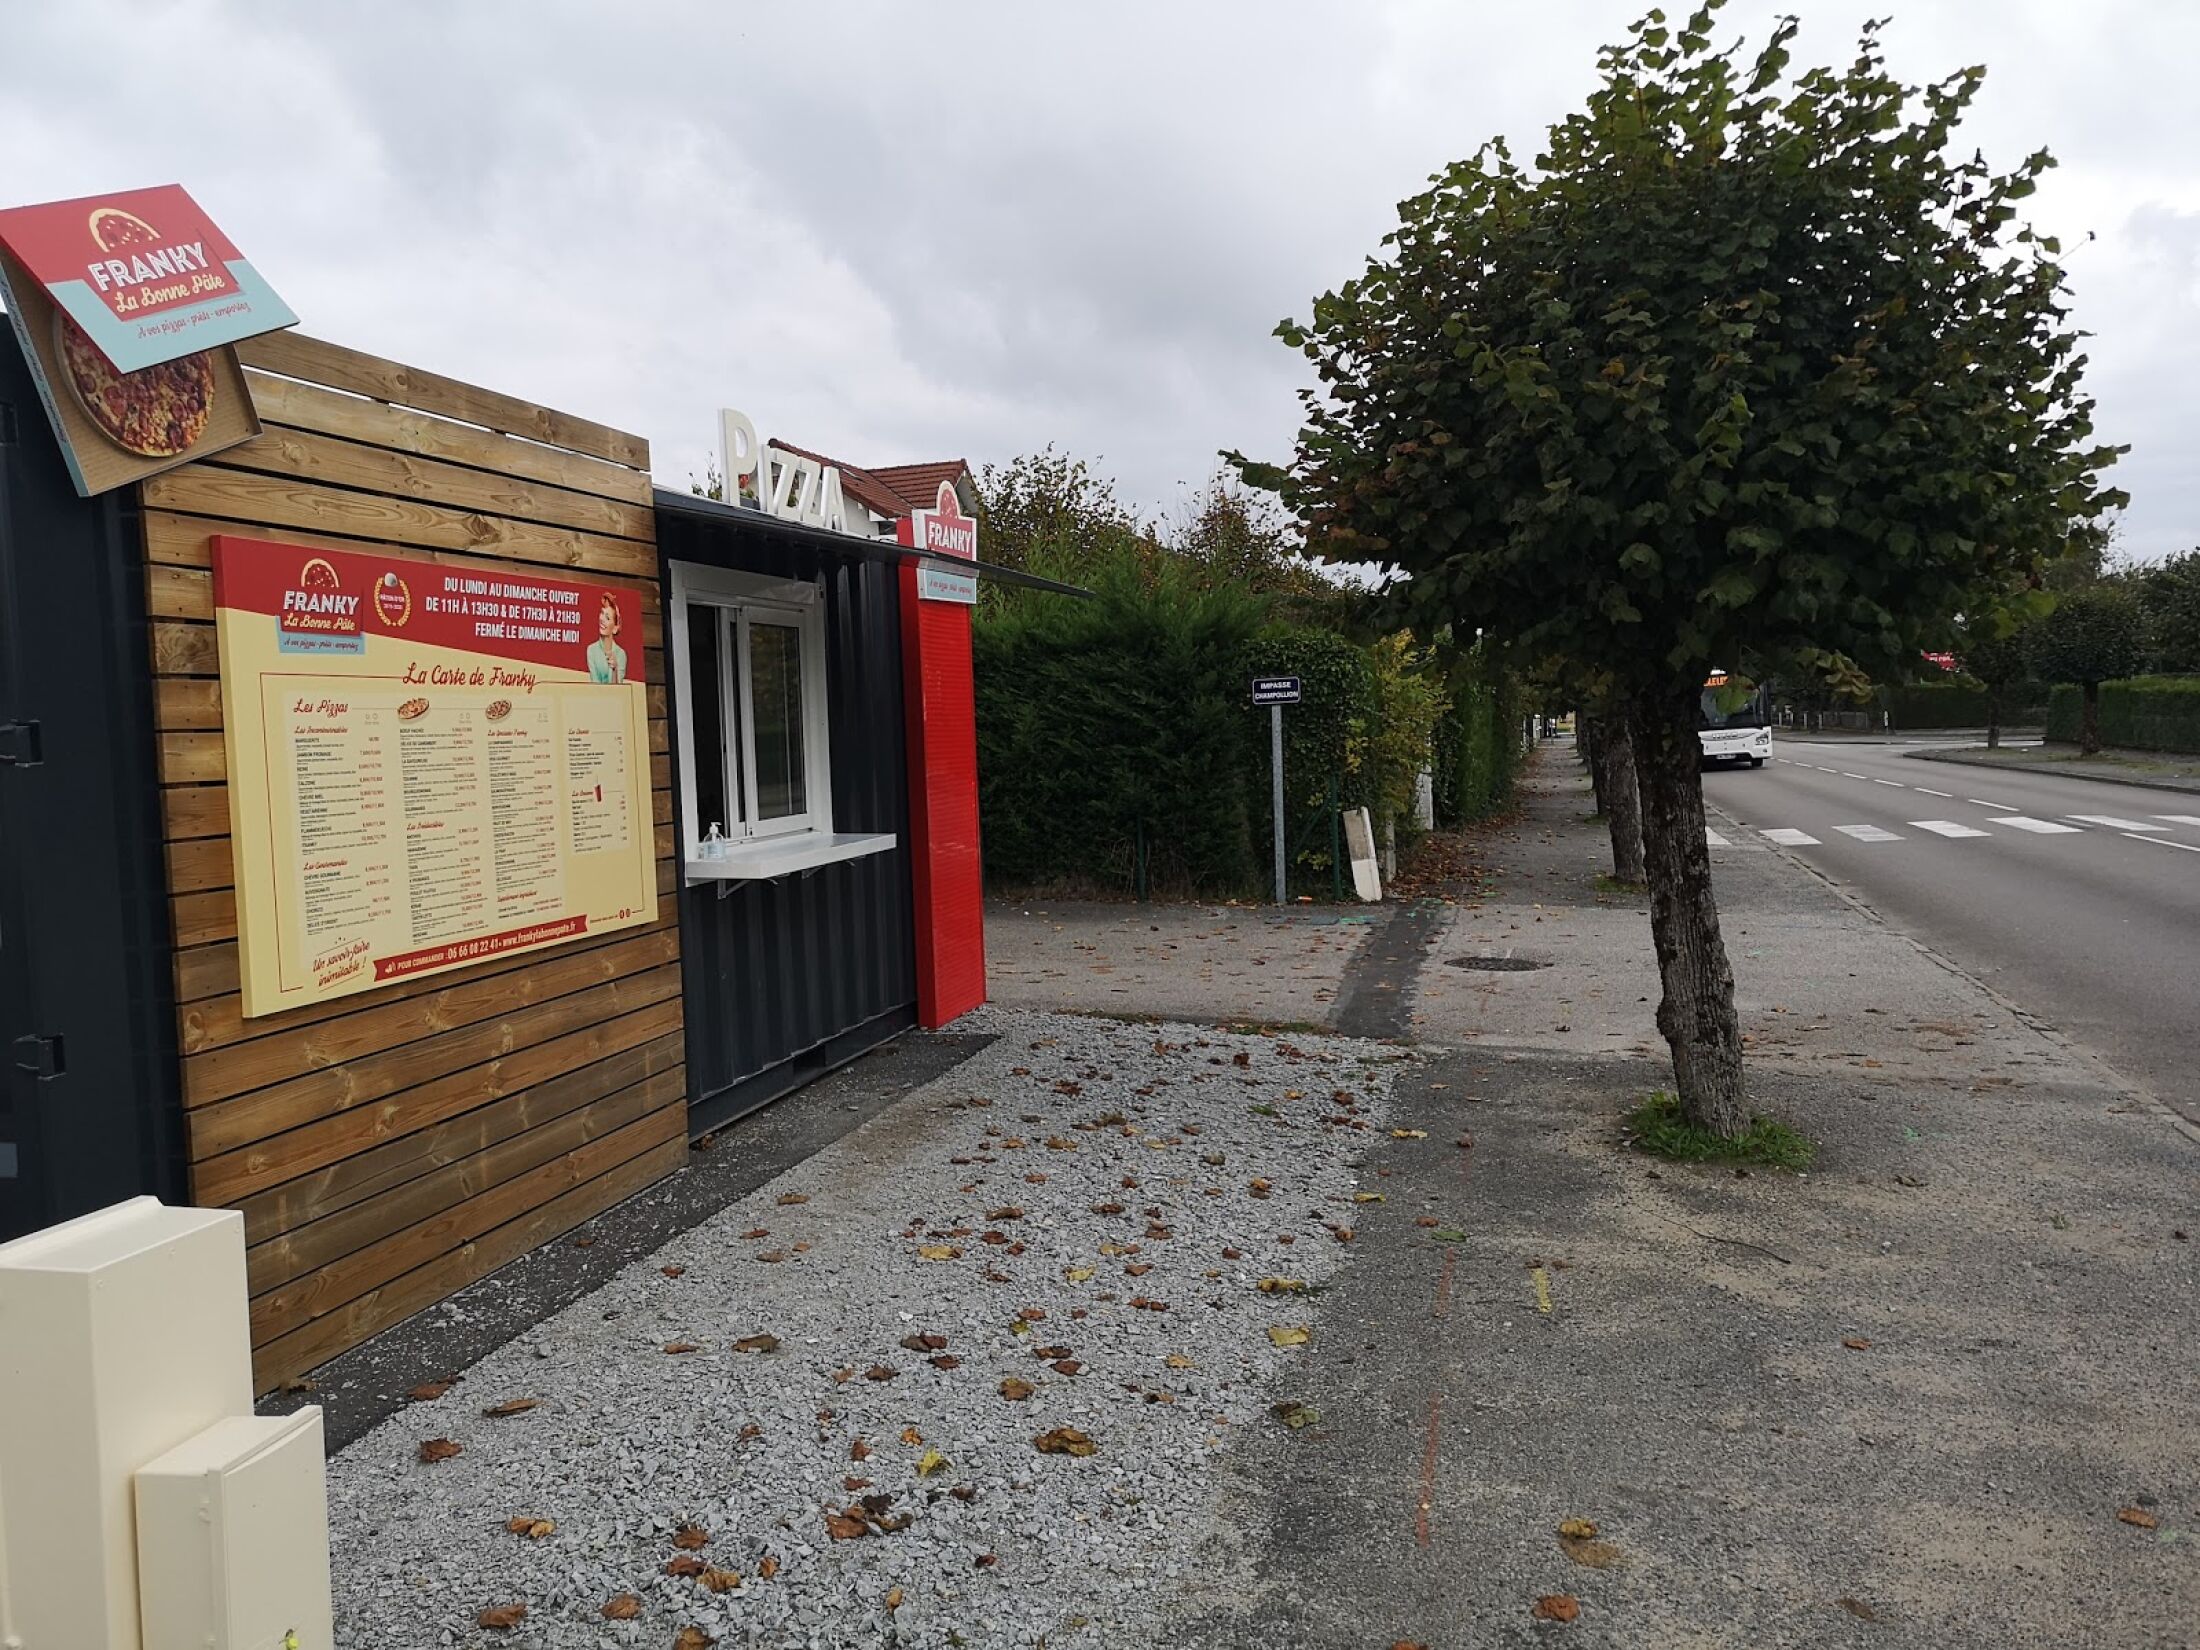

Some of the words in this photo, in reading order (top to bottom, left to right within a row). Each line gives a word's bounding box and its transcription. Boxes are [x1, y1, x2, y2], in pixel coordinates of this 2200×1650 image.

[88, 242, 208, 291] FRANKY
[115, 289, 139, 313] La
[141, 283, 190, 307] Bonne
[192, 273, 225, 294] Pâte
[161, 319, 186, 333] pizzas
[718, 408, 848, 533] PIZZA
[928, 521, 972, 553] FRANKY
[283, 590, 360, 616] FRANKY
[444, 576, 458, 592] DU
[460, 578, 487, 595] LUNDI
[489, 583, 501, 598] AU
[504, 584, 548, 602] DIMANCHE
[549, 590, 580, 606] OUVERT
[284, 612, 299, 627] La
[300, 614, 331, 630] Bonne
[333, 616, 355, 631] Pâte
[425, 597, 439, 611] DE
[441, 598, 460, 614] 11H
[461, 597, 469, 614] À
[471, 602, 499, 618] 13H30
[501, 605, 507, 618] &
[509, 605, 521, 619] DE
[522, 606, 547, 622] 17H30
[548, 606, 555, 622] À
[556, 610, 580, 625] 21H30
[475, 620, 504, 638] FERMÉ
[506, 625, 517, 639] LE
[518, 626, 561, 642] DIMANCHE
[562, 629, 580, 643] MIDI
[403, 662, 428, 684] La
[431, 665, 465, 686] Carte
[470, 666, 484, 685] de
[489, 667, 536, 694] Franky
[1260, 681, 1291, 690] IMPASSE
[294, 698, 314, 713] Les
[317, 699, 348, 718] Pizzas
[479, 939, 489, 952] 22
